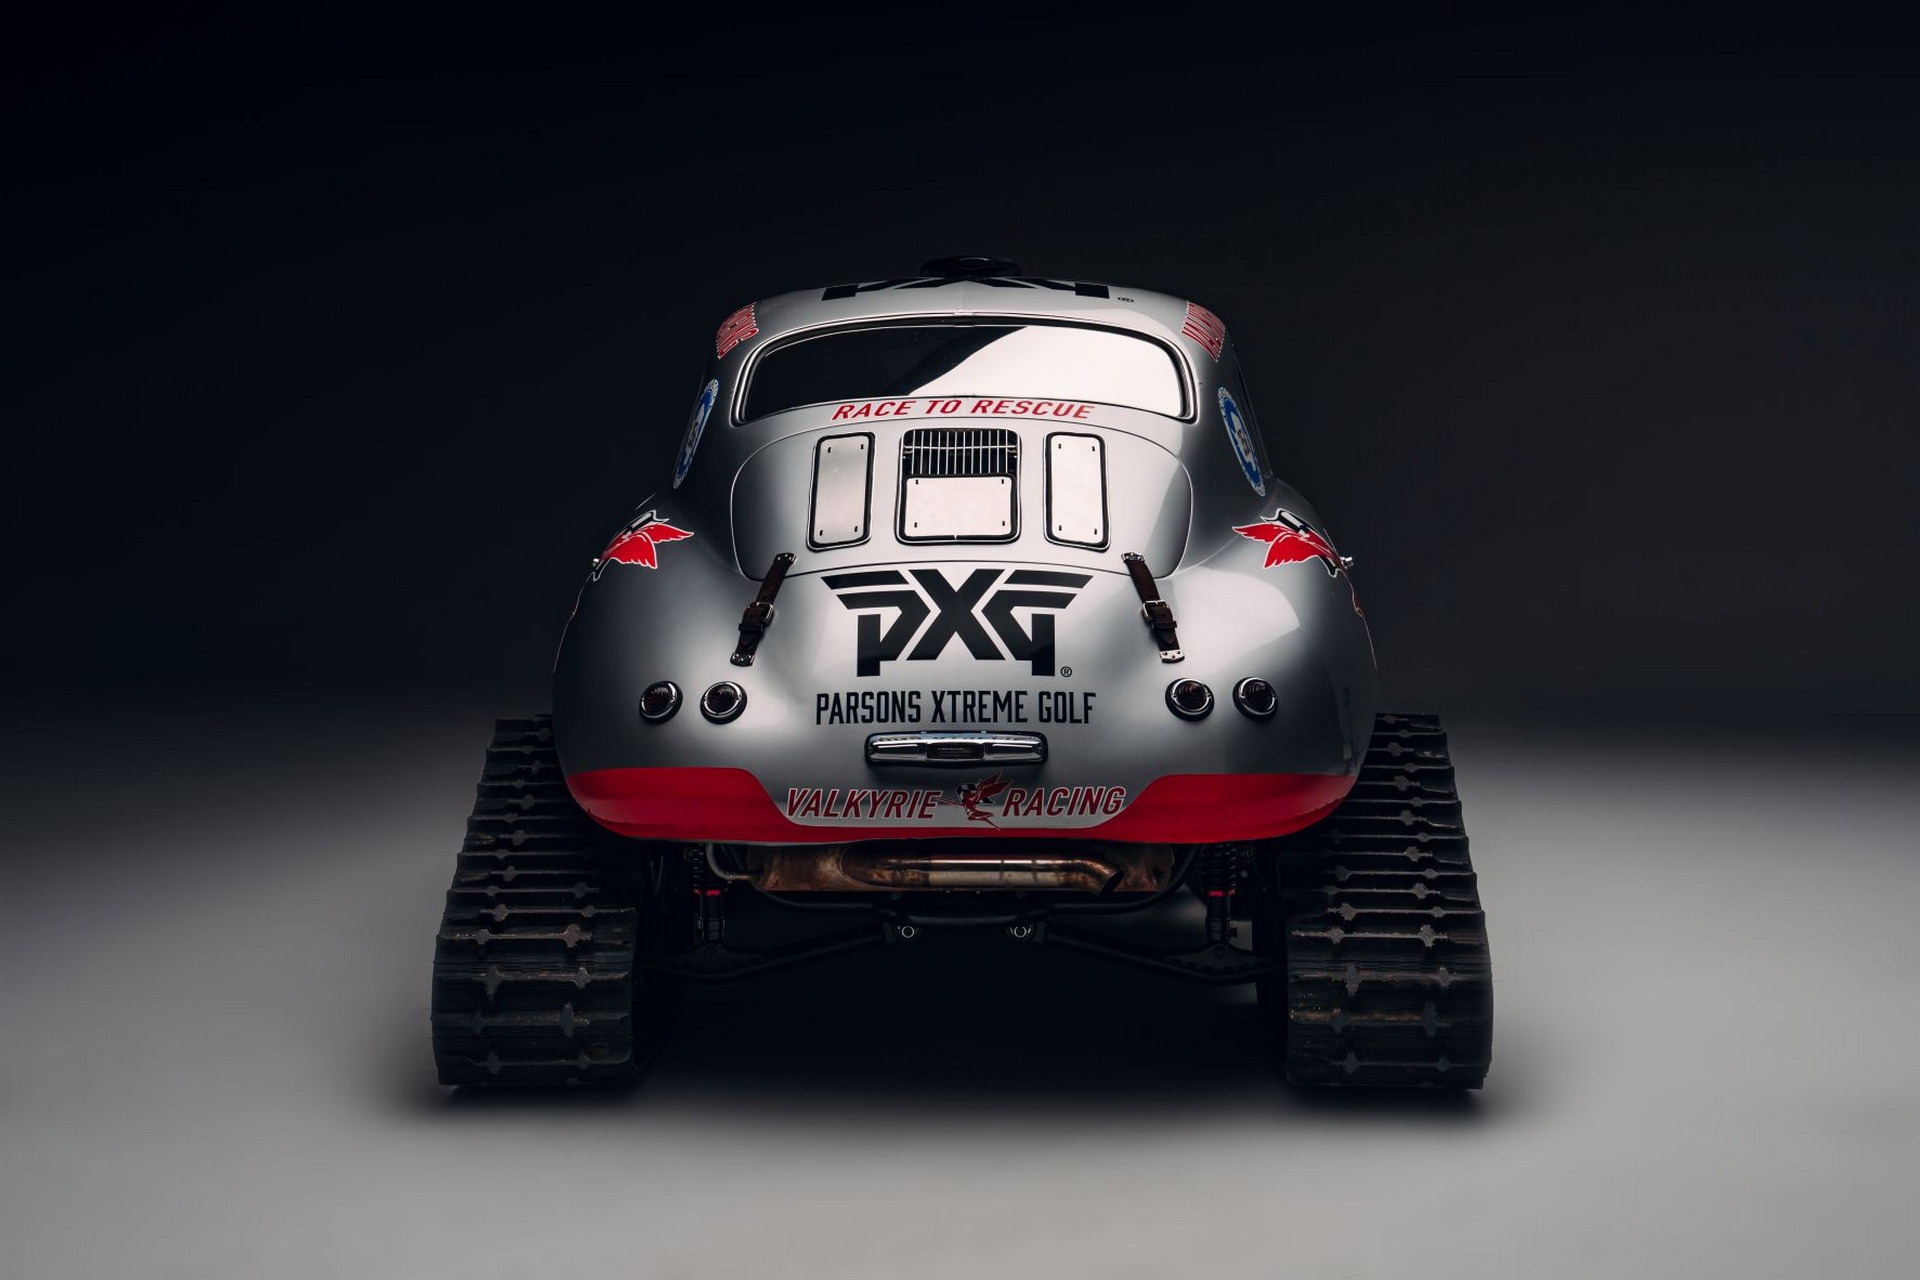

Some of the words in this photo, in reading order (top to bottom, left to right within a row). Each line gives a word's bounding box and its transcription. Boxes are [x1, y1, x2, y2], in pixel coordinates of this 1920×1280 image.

[832, 400, 916, 421] RACE
[925, 399, 963, 415] TO
[970, 399, 1095, 419] RESCUE
[816, 690, 921, 725] PARSONS
[931, 689, 1029, 723] XTREME
[1038, 690, 1097, 724] GOLF
[786, 787, 943, 820] VALKYRIE
[1001, 785, 1127, 818] RACING
